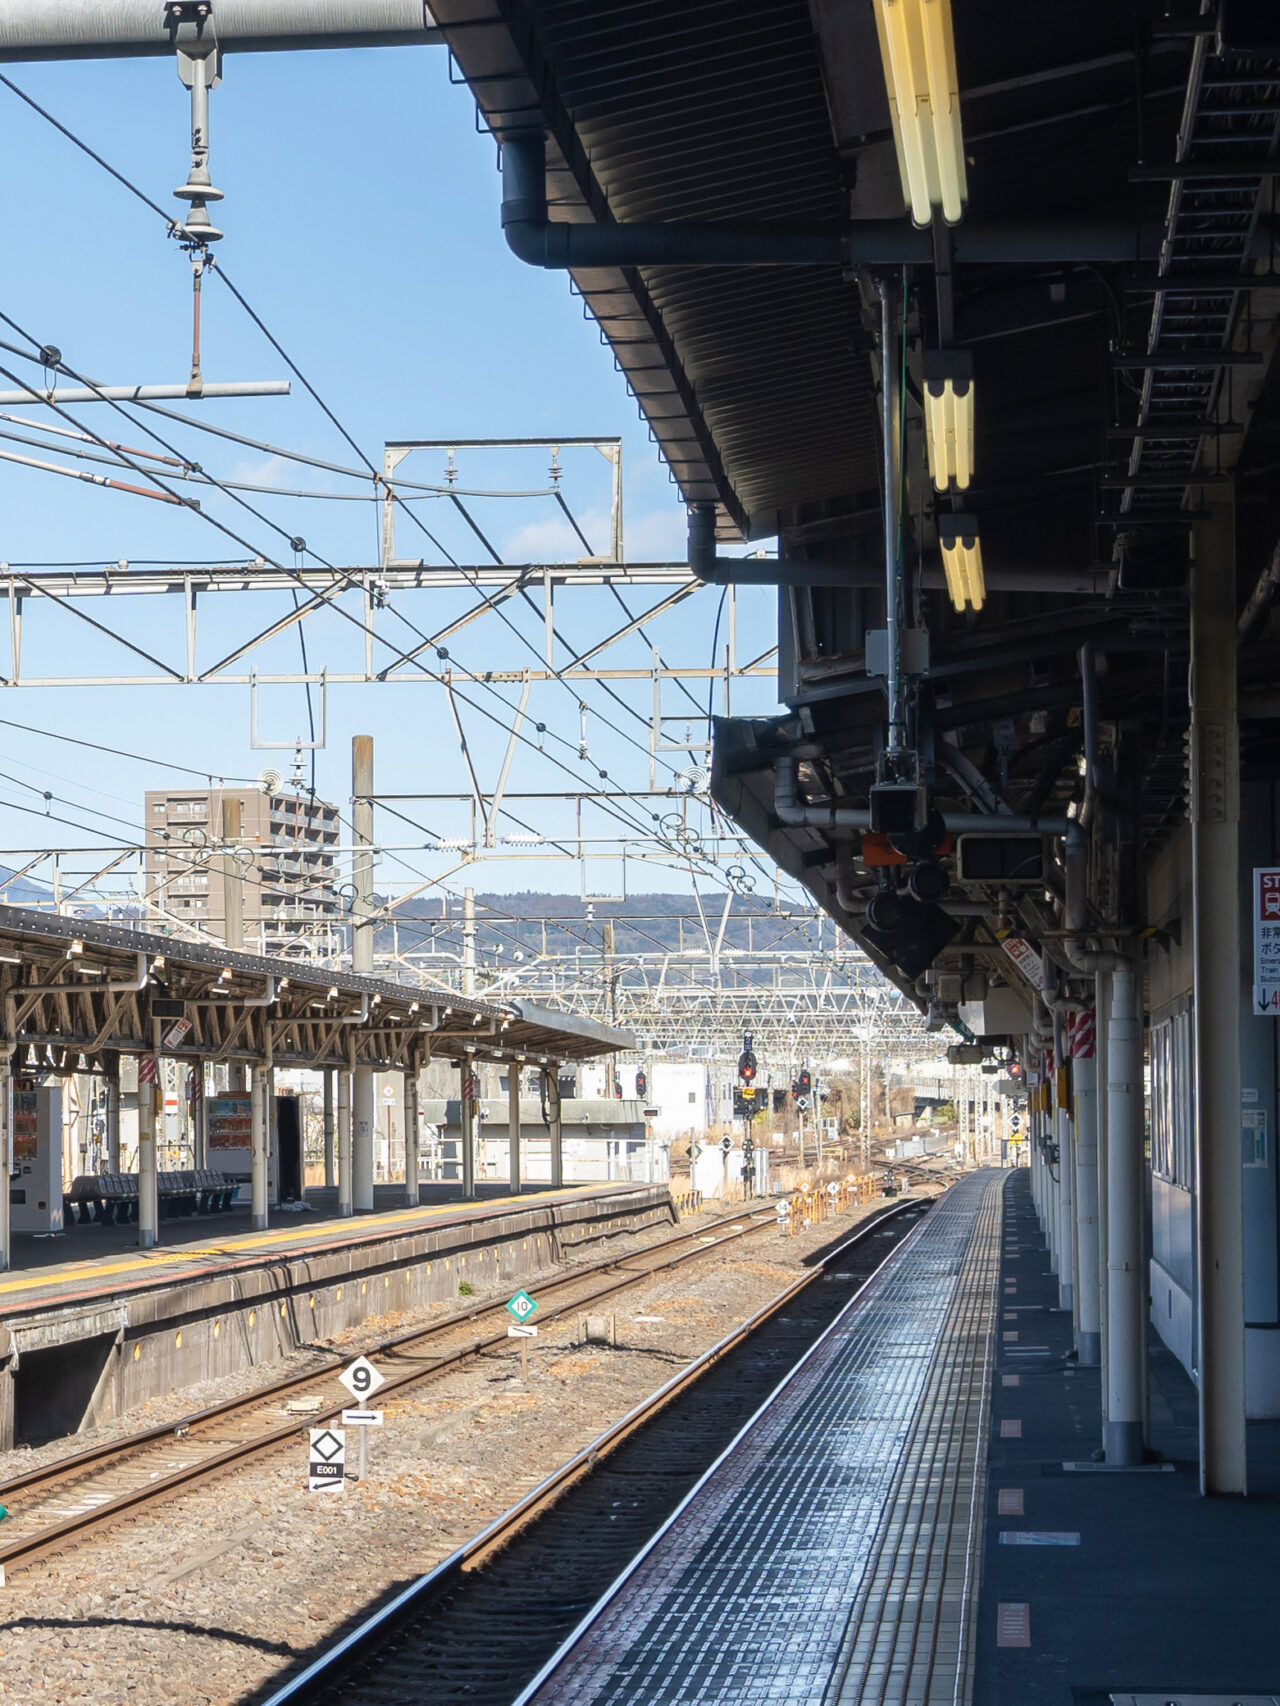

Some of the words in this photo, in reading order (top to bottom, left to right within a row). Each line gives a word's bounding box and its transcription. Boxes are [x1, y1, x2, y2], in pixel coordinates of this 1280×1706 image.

[1271, 990, 1280, 1009] 4
[517, 1301, 528, 1311] 10
[352, 1366, 371, 1391] 9
[316, 1465, 337, 1475] E001
